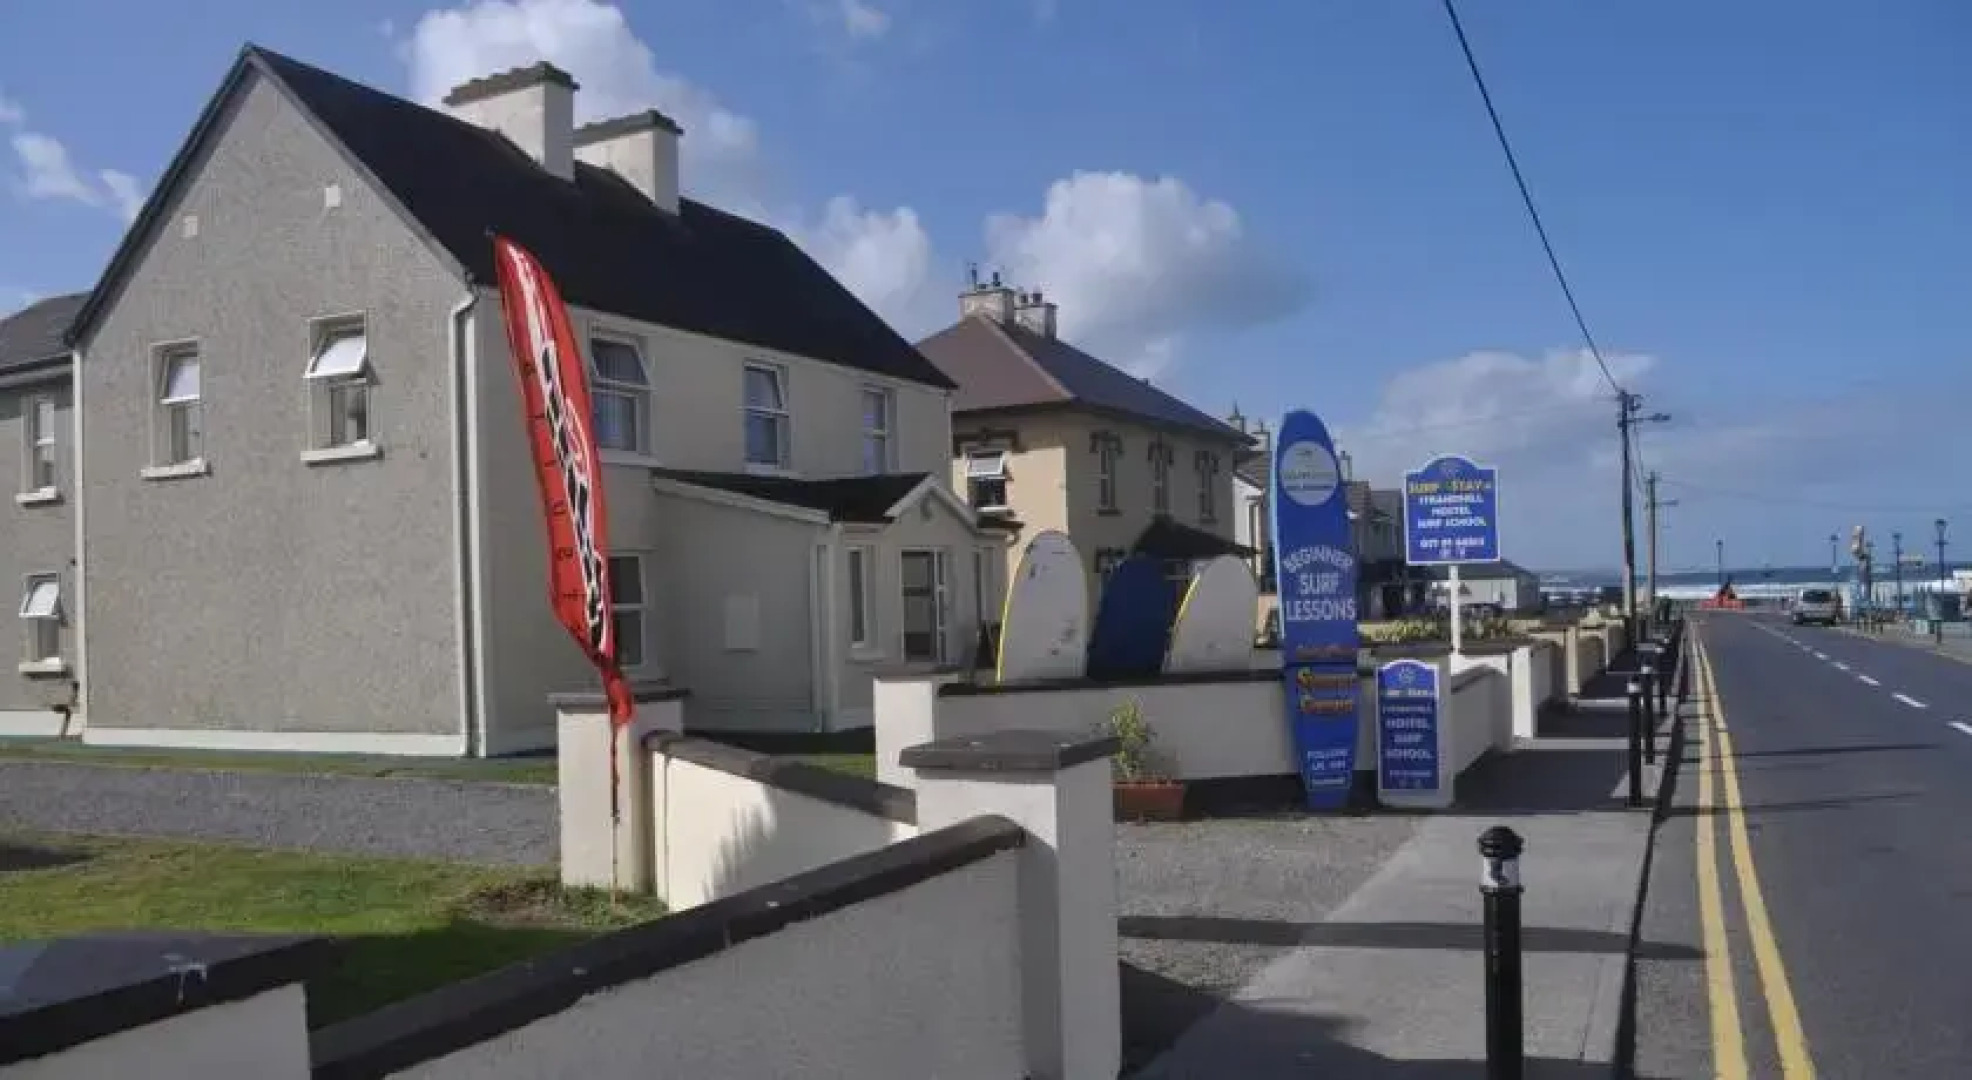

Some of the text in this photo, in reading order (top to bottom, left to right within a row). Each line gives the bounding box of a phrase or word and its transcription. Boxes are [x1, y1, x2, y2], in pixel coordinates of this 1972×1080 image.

[1284, 545, 1354, 574] BEGINNER
[1300, 573, 1339, 594] SURF
[1286, 600, 1356, 620] LESSONS
